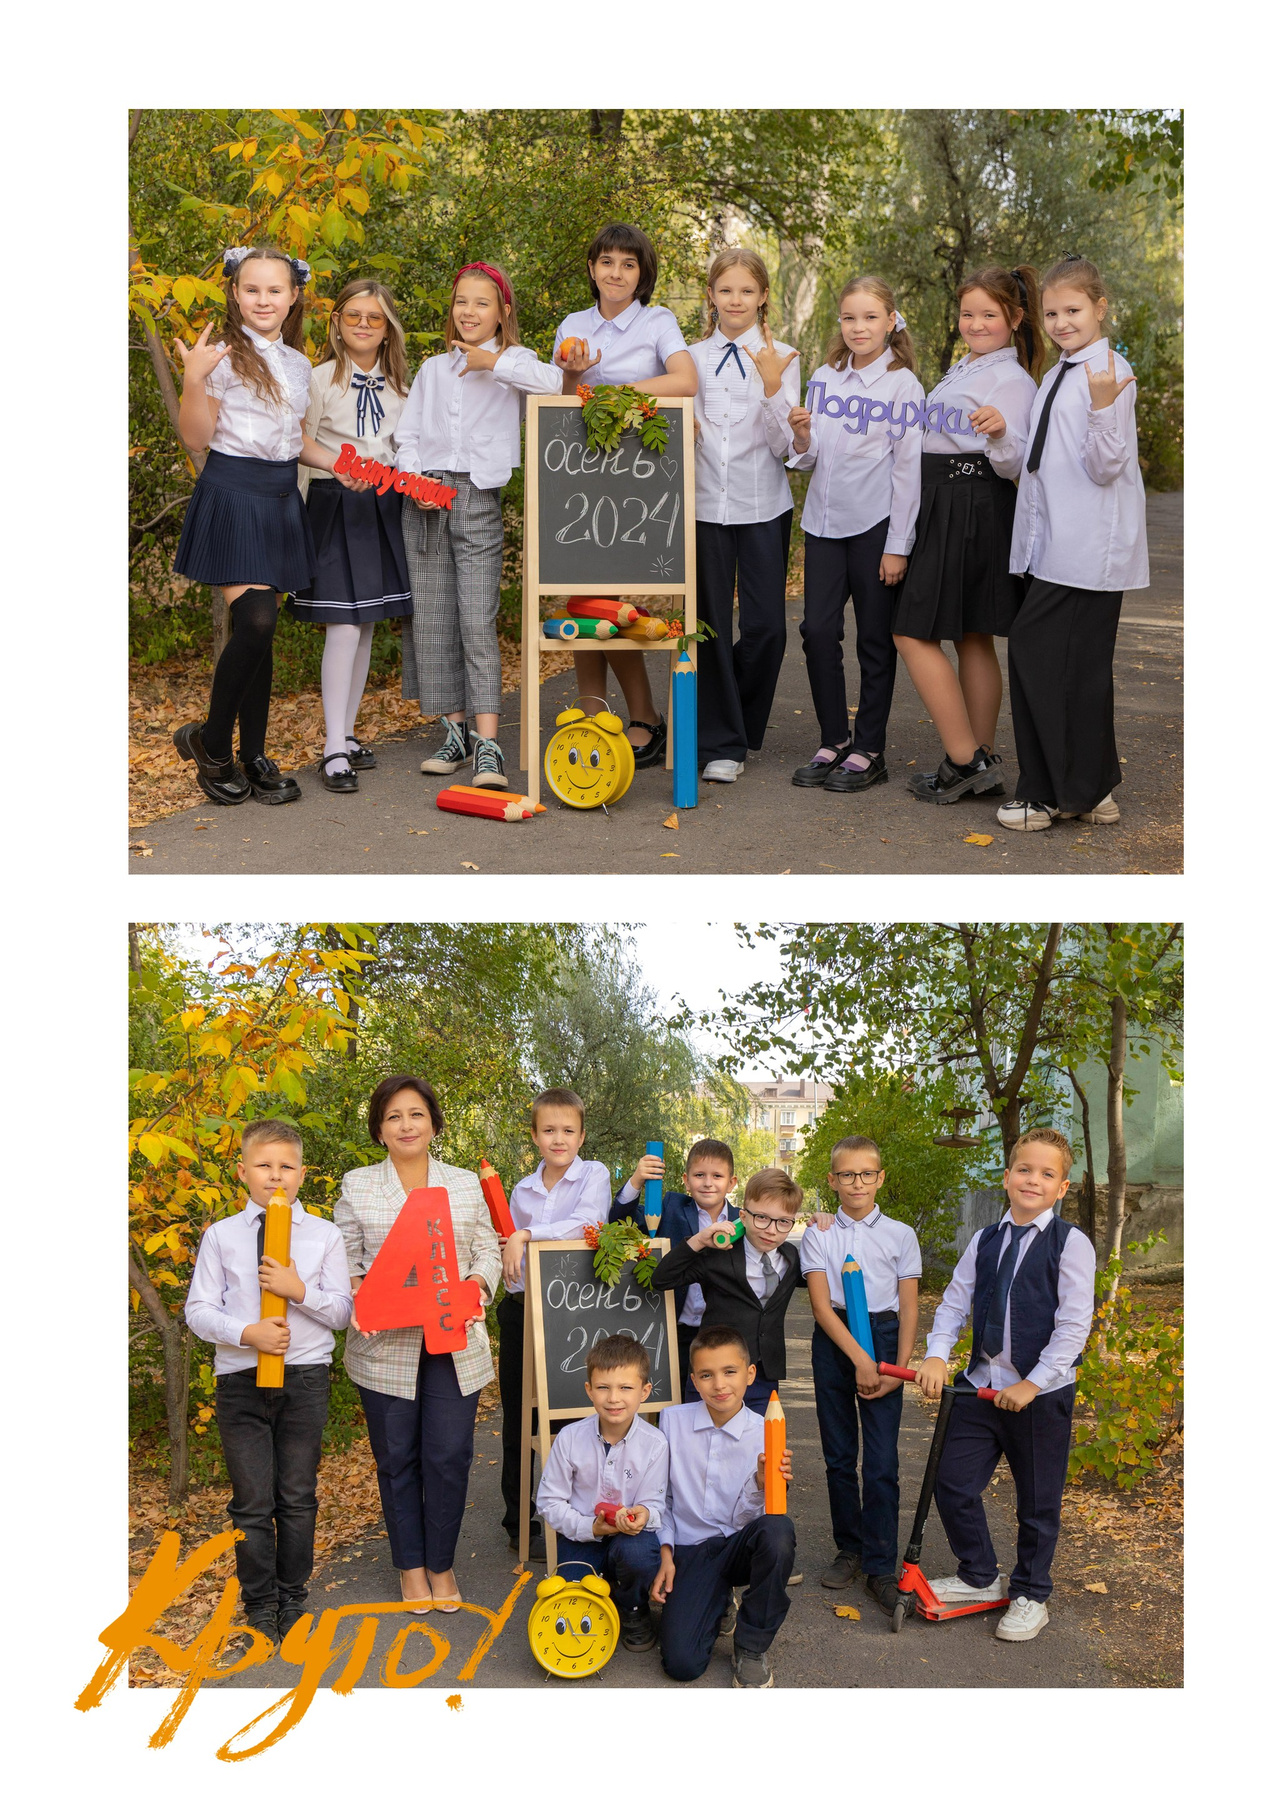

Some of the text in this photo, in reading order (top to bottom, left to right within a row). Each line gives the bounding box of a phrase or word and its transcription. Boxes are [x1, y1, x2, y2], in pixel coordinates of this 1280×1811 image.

[806, 380, 978, 441] Подружки
[334, 443, 457, 510] Выпускник
[555, 491, 680, 548] 2024
[353, 1186, 483, 1355] 4
[560, 1321, 665, 1373] 24
